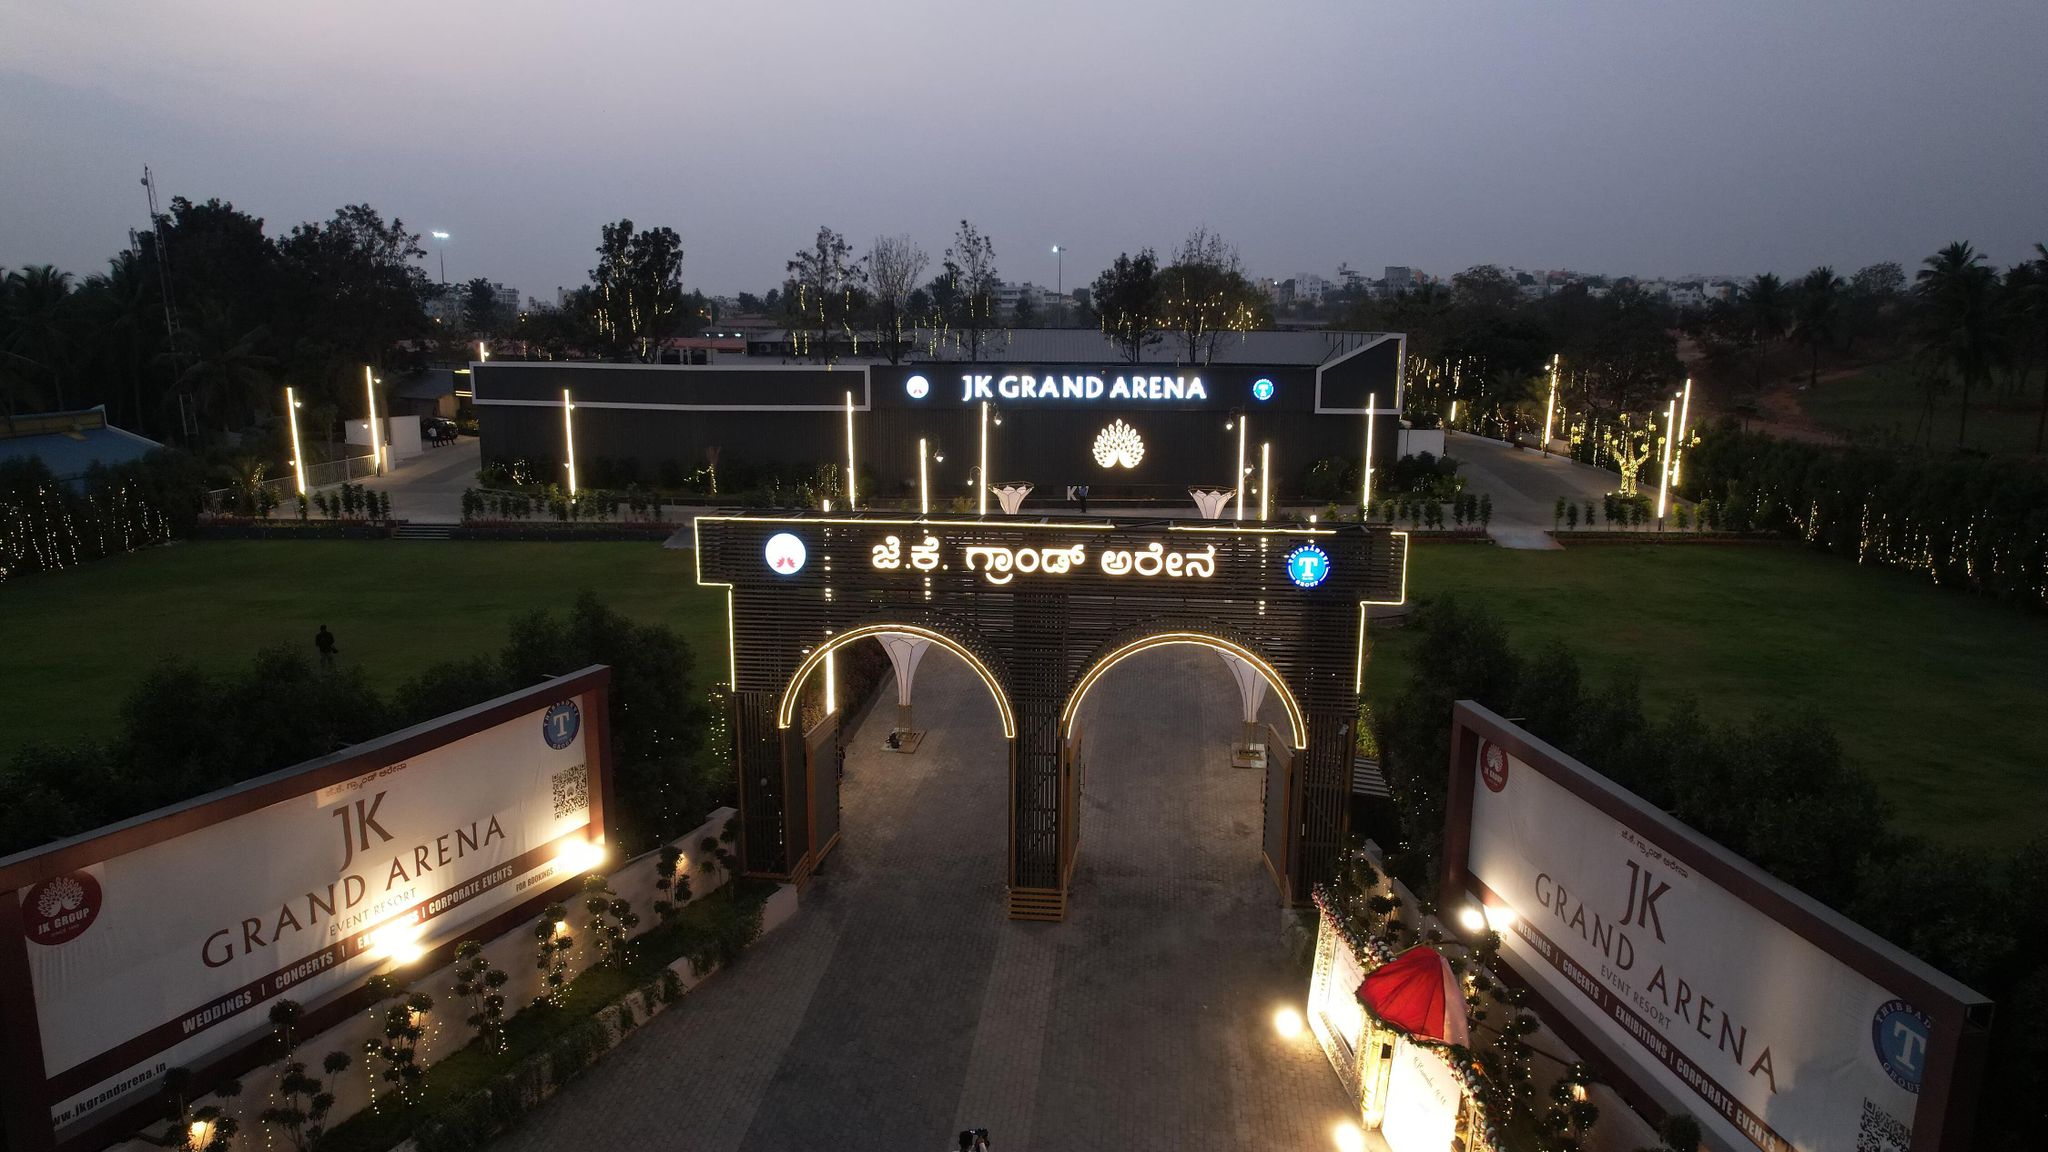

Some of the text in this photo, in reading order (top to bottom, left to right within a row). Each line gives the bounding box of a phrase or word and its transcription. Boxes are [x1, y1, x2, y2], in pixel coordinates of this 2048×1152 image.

[962, 375, 1207, 401] JK GRAND ARENA
[966, 544, 1086, 584] ಗ್ರಾಂಡ್
[1101, 542, 1216, 577] ಅರೇನ
[332, 790, 394, 872] JK
[202, 874, 366, 968] GRAND
[385, 814, 506, 891] ARENA
[515, 867, 554, 892] FOR BOOKINGS
[1618, 858, 1672, 945] JK
[54, 907, 90, 928] GROUP
[182, 865, 513, 1034] WEDDINGS CONCERTS CORPORATE EVENTS
[329, 909, 369, 936] EVENT
[1535, 872, 1777, 1095] GRAND ARENA
[1600, 965, 1672, 1030] EVENT RESORT
[1518, 920, 1777, 1152] WEDDINGS CONCERTS EXHIBITIONS CORPORATE EVENTS
[1893, 1020, 1927, 1072] T
